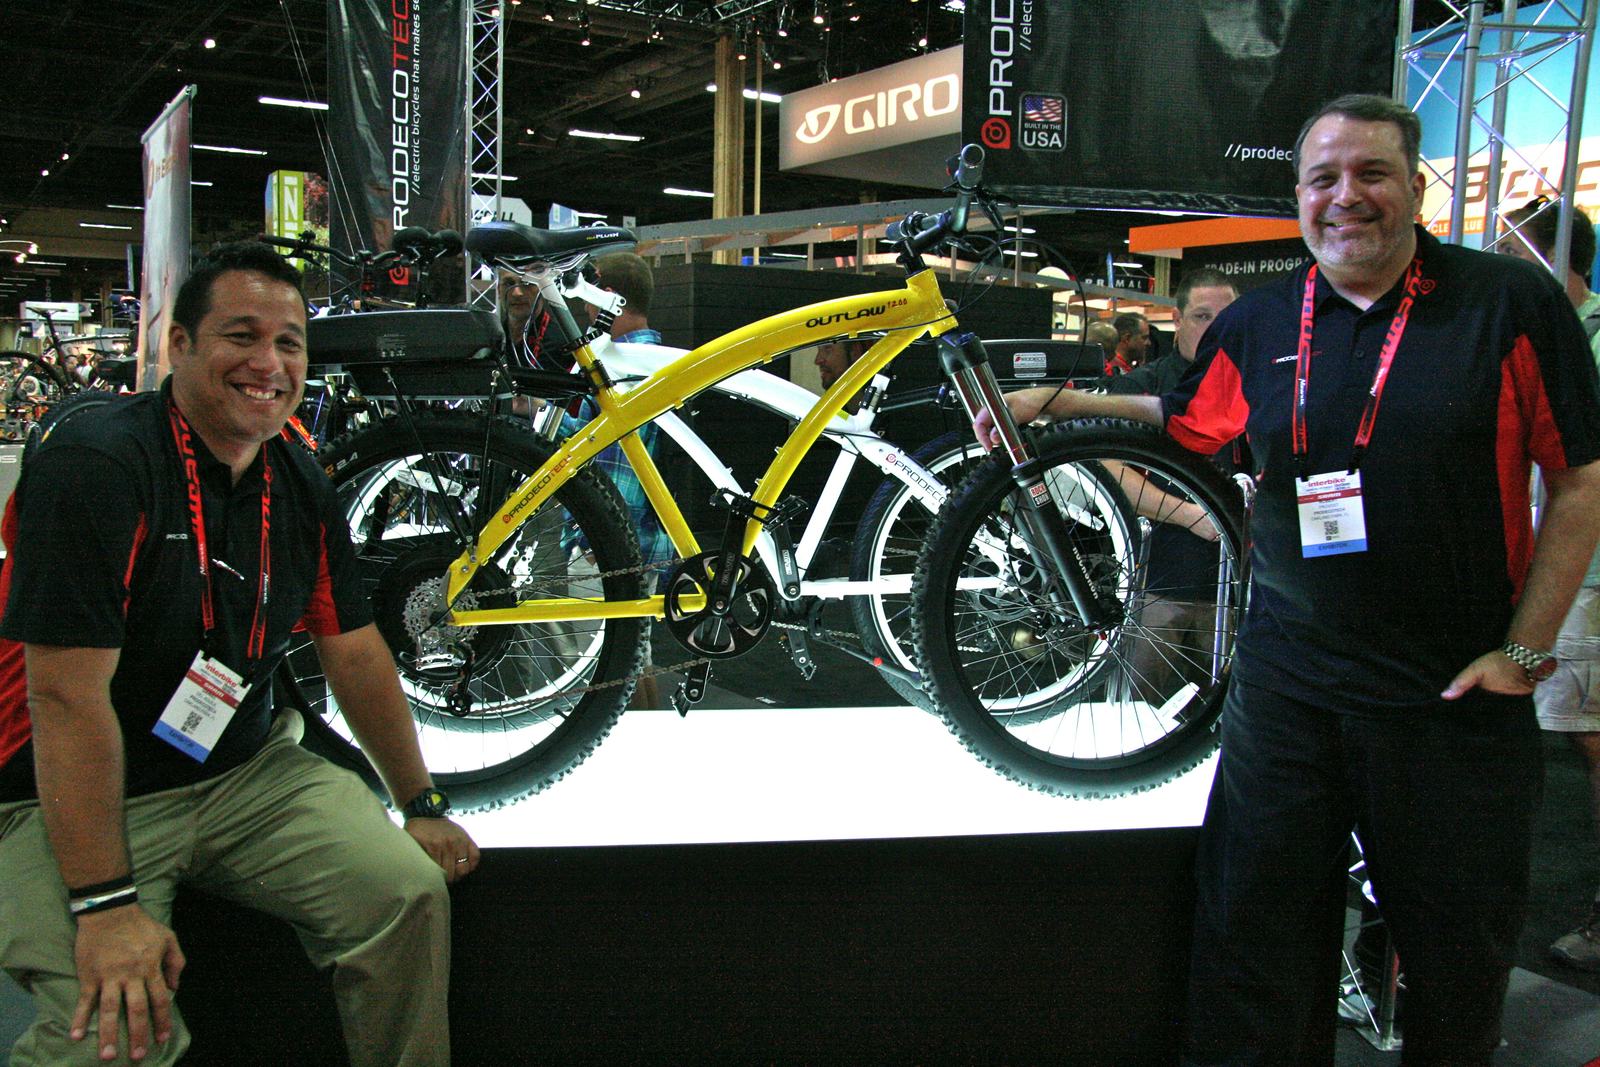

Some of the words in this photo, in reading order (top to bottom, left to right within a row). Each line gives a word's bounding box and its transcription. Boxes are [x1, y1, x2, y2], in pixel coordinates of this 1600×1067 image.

[411, 13, 421, 56] makes
[411, 58, 421, 83] that
[391, 0, 409, 231] RODECOTEC
[411, 86, 422, 136] bicycles
[844, 73, 960, 135] GIRO
[1024, 122, 1041, 130] BUILT
[1049, 123, 1062, 131] THE
[1023, 131, 1062, 148] USA
[1224, 144, 1294, 161] //prodec
[1084, 278, 1143, 289] PRMAL
[805, 305, 886, 328] OUTLAW
[205, 663, 237, 687] interbike
